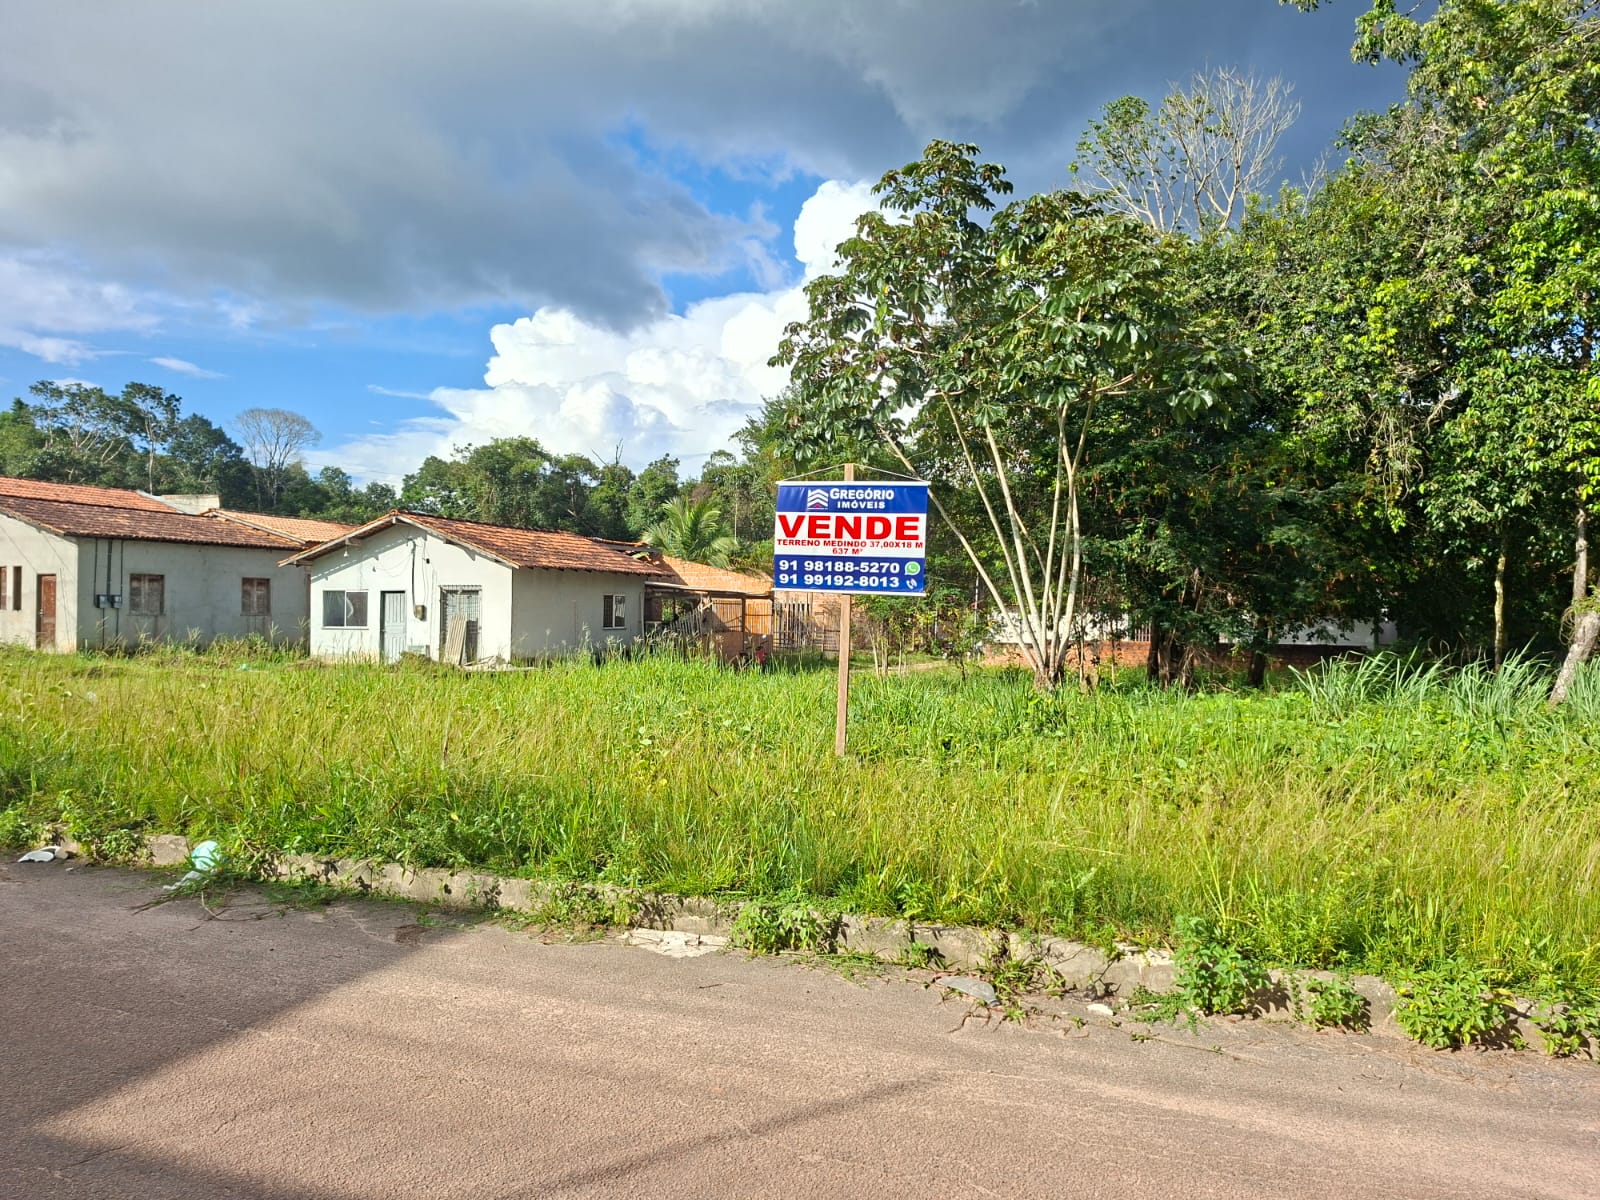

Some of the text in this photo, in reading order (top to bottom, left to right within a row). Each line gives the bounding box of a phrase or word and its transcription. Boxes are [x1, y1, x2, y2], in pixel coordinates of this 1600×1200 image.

[830, 488, 894, 500] GREGÓRIO
[837, 500, 886, 509] IMÓVEIS
[778, 514, 920, 540] VENDE
[870, 541, 912, 549] 37,00X18
[779, 560, 900, 574] 91 98188-5270
[779, 574, 900, 587] 91 99192-8013
